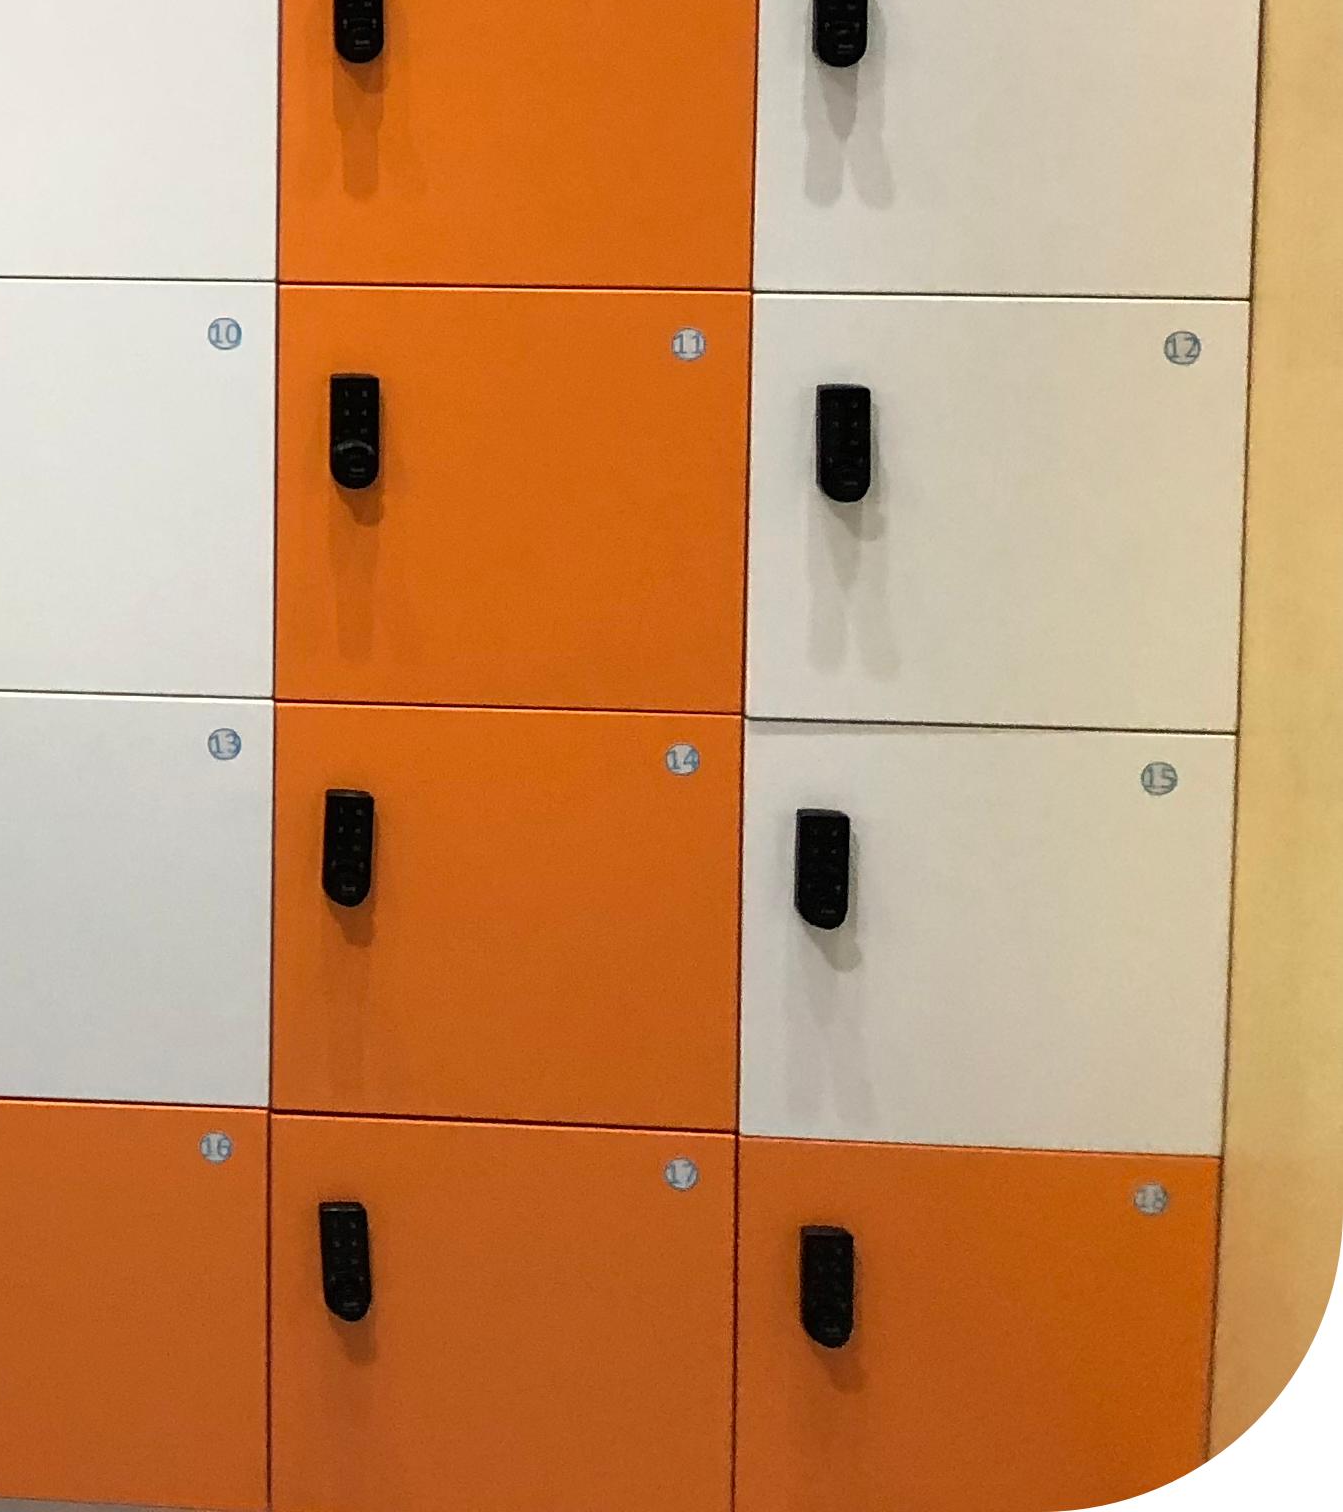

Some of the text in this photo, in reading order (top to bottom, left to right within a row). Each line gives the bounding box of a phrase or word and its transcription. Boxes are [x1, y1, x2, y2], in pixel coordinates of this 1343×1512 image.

[209, 322, 240, 345] 10
[674, 332, 704, 355] 11
[1167, 334, 1198, 359] 12
[210, 733, 240, 755] 13
[668, 748, 698, 771] 14
